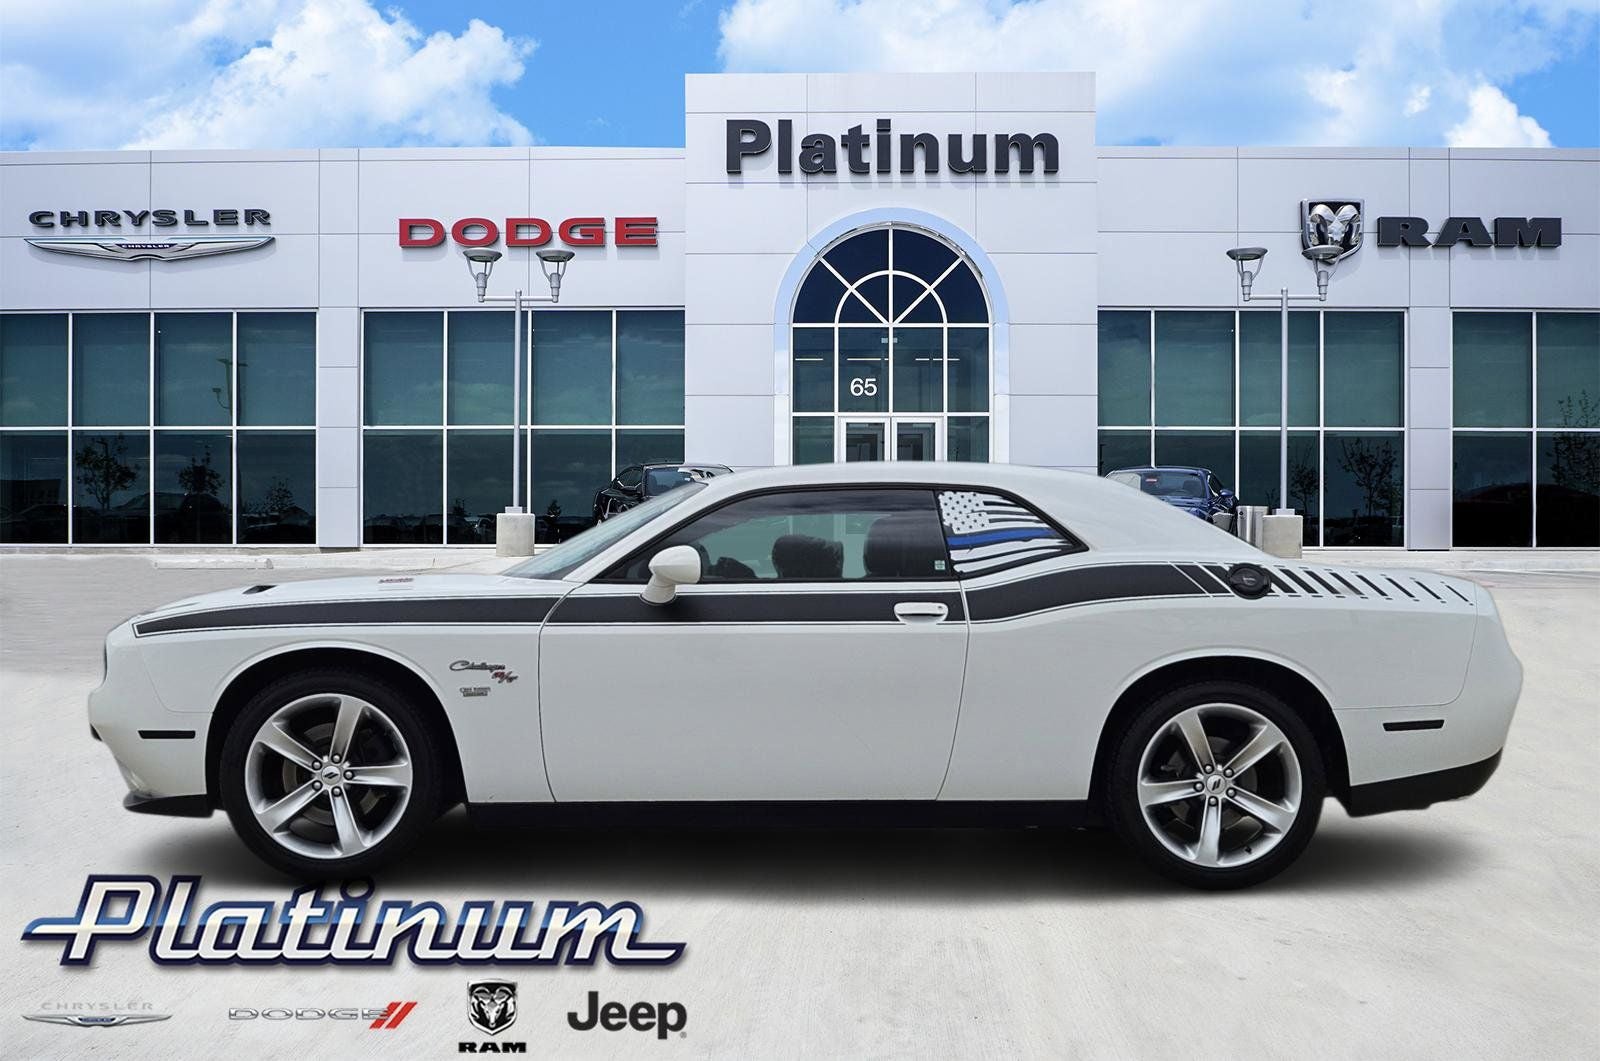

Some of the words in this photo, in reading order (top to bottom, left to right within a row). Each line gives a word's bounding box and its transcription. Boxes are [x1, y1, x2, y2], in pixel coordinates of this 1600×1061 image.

[726, 119, 1059, 174] Platinum
[29, 208, 271, 228] CHRYSLER
[399, 217, 658, 248] DODGE
[1377, 216, 1562, 248] RAM
[850, 377, 878, 397] 65
